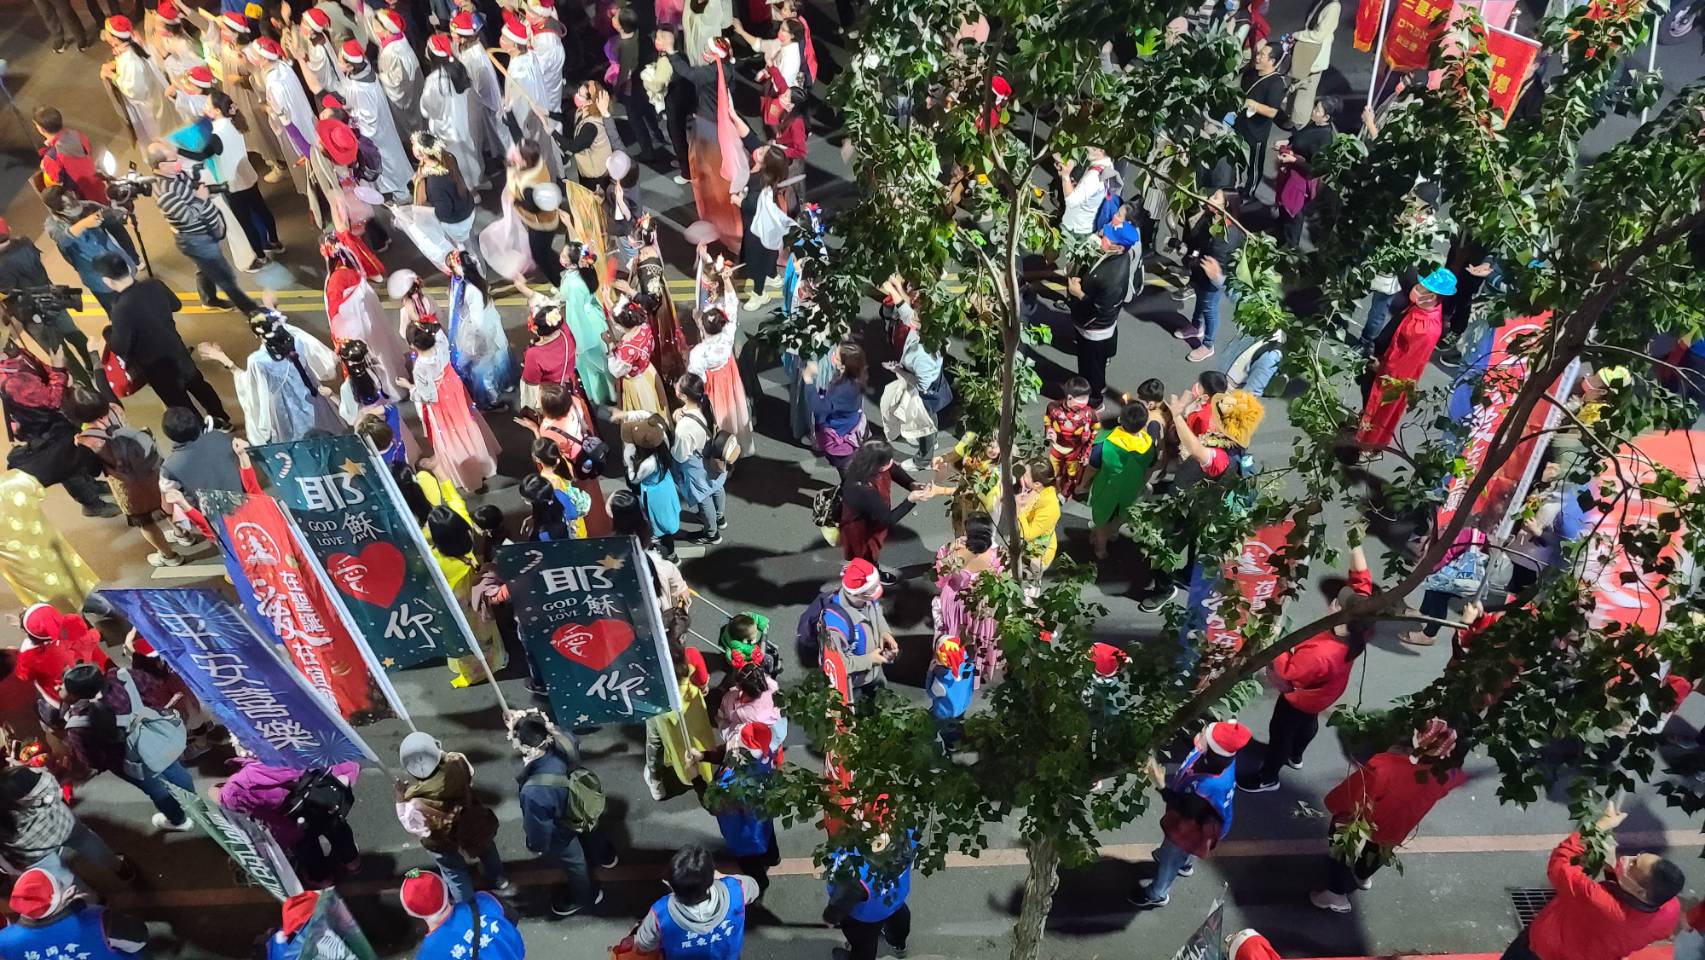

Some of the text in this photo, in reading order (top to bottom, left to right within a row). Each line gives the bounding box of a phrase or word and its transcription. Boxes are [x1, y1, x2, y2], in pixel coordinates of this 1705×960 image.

[295, 472, 365, 513] 耶
[308, 520, 338, 532] GOD
[316, 536, 345, 546] LOVE
[342, 511, 388, 545] 穌
[539, 565, 613, 595] 耶
[542, 597, 578, 611] GOD
[547, 610, 580, 622] LOVE
[582, 594, 625, 617] 穌
[384, 603, 441, 649] 你
[156, 611, 321, 750] 平安喜樂
[585, 670, 650, 715] 你
